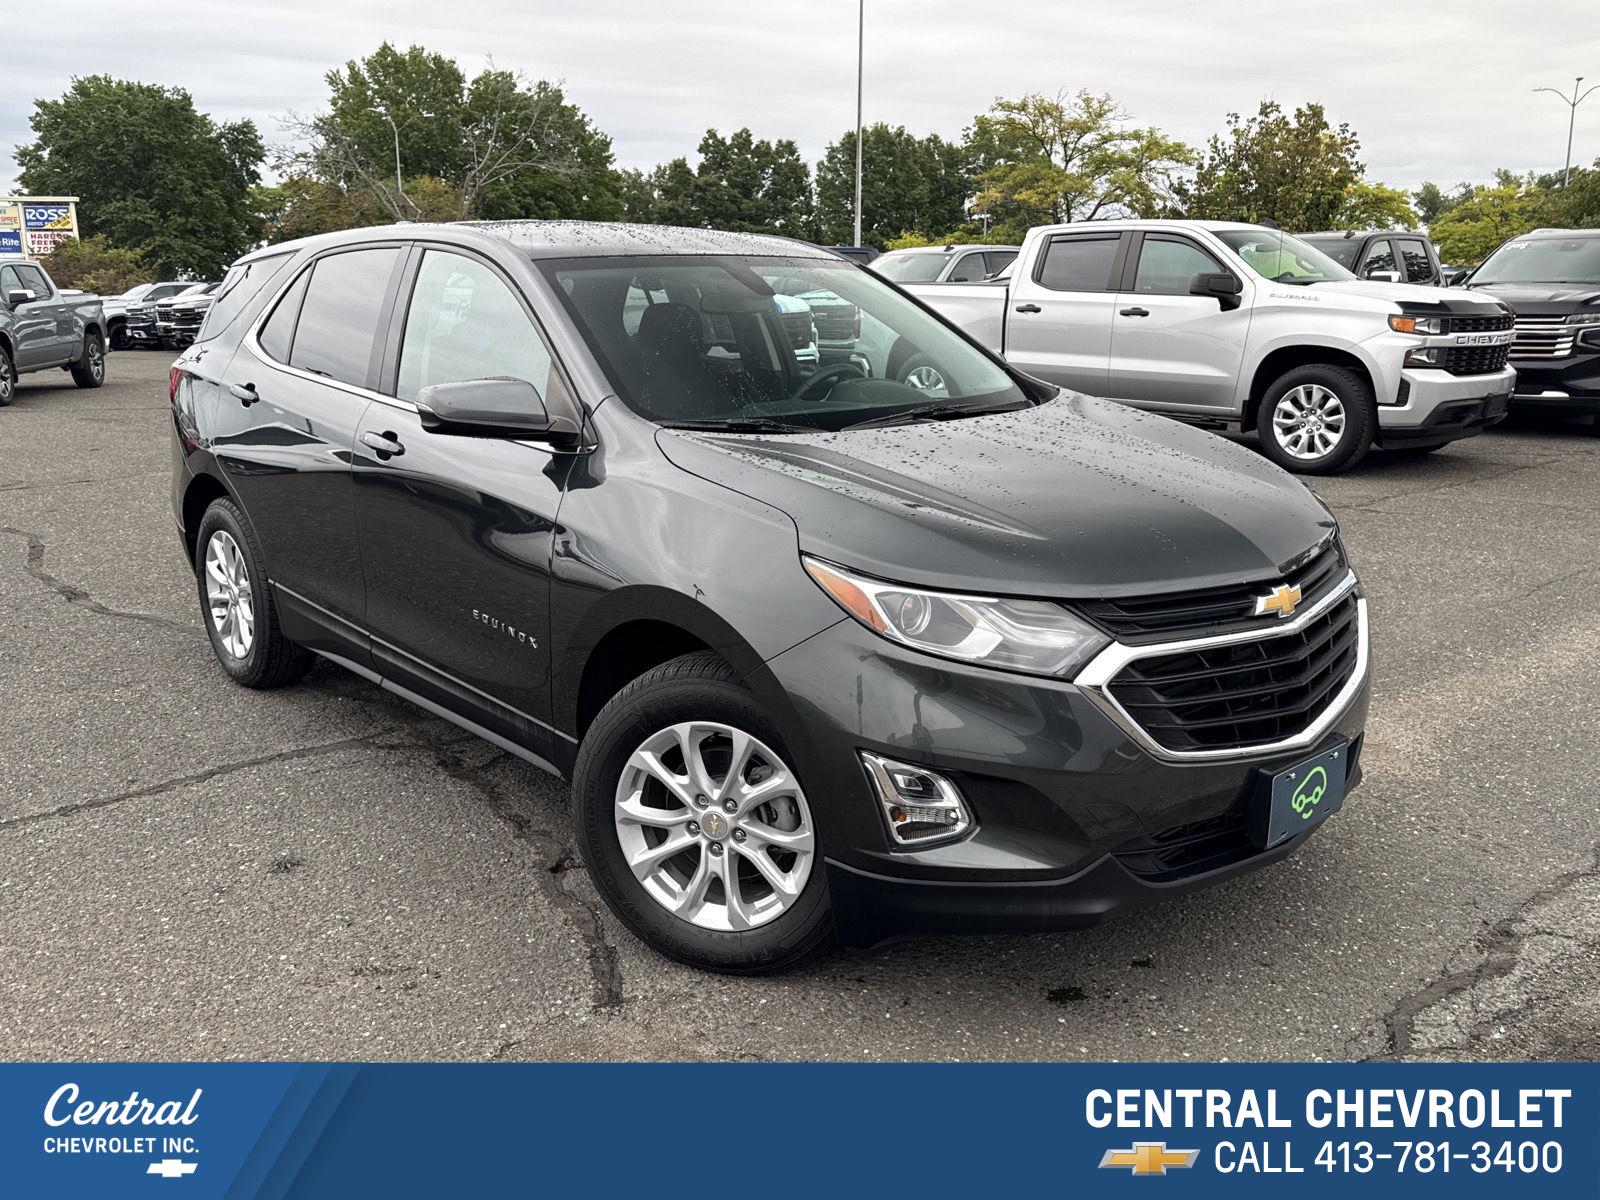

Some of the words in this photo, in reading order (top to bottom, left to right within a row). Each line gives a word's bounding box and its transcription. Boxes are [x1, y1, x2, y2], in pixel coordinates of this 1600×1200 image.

[25, 208, 68, 220] ROSS
[50, 214, 70, 228] COMING
[472, 609, 538, 649] EQUINOX
